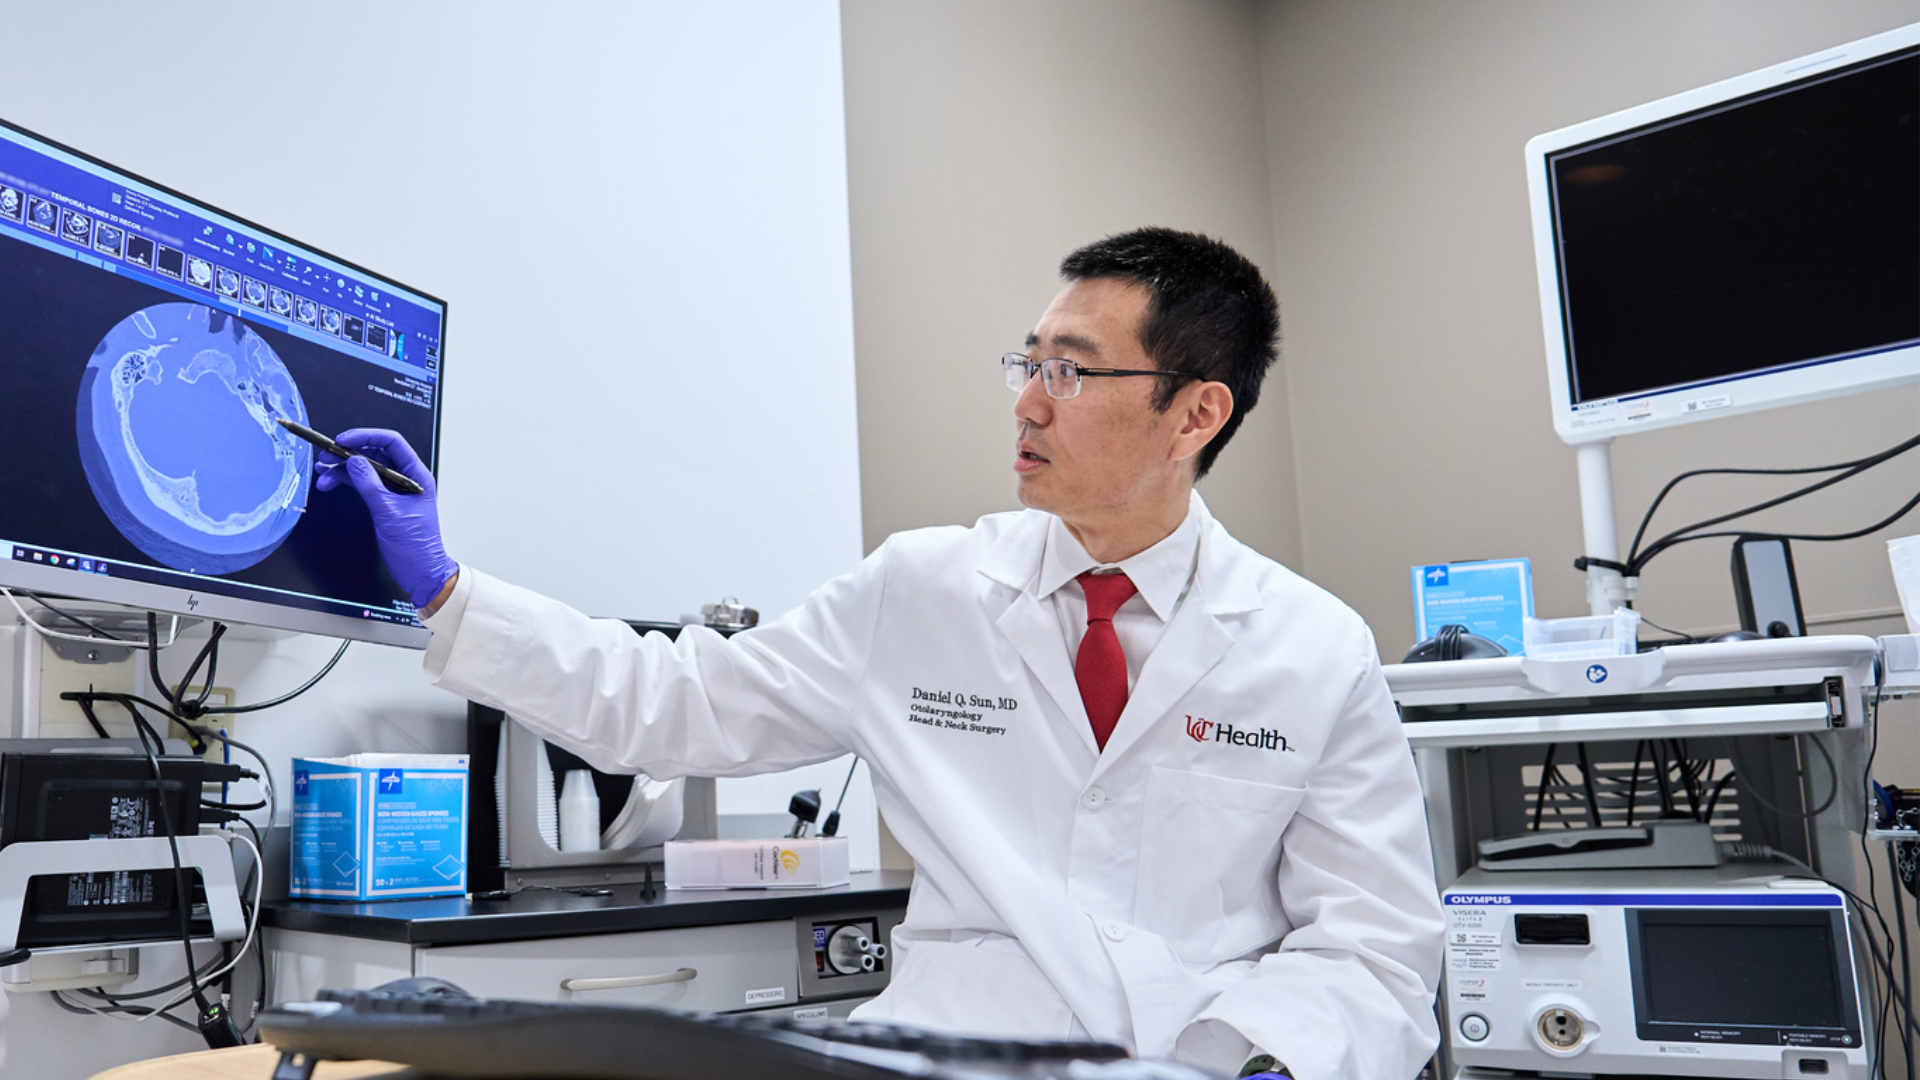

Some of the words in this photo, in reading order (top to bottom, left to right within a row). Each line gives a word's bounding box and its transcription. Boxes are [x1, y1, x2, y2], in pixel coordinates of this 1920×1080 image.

[51, 191, 86, 210] TEMPORAL
[87, 205, 109, 219] BONES
[912, 687, 951, 704] Daniel
[969, 694, 996, 710] Sun,
[998, 697, 1018, 710] MD
[910, 703, 983, 721] Otolaryngology
[908, 714, 933, 726] Head
[935, 719, 943, 727] &
[945, 720, 968, 731] Neck
[969, 723, 1006, 735] Surgery
[1215, 723, 1287, 752] Health
[1451, 895, 1512, 904] OLYMPUS
[747, 990, 784, 1000] DEPRESSORS
